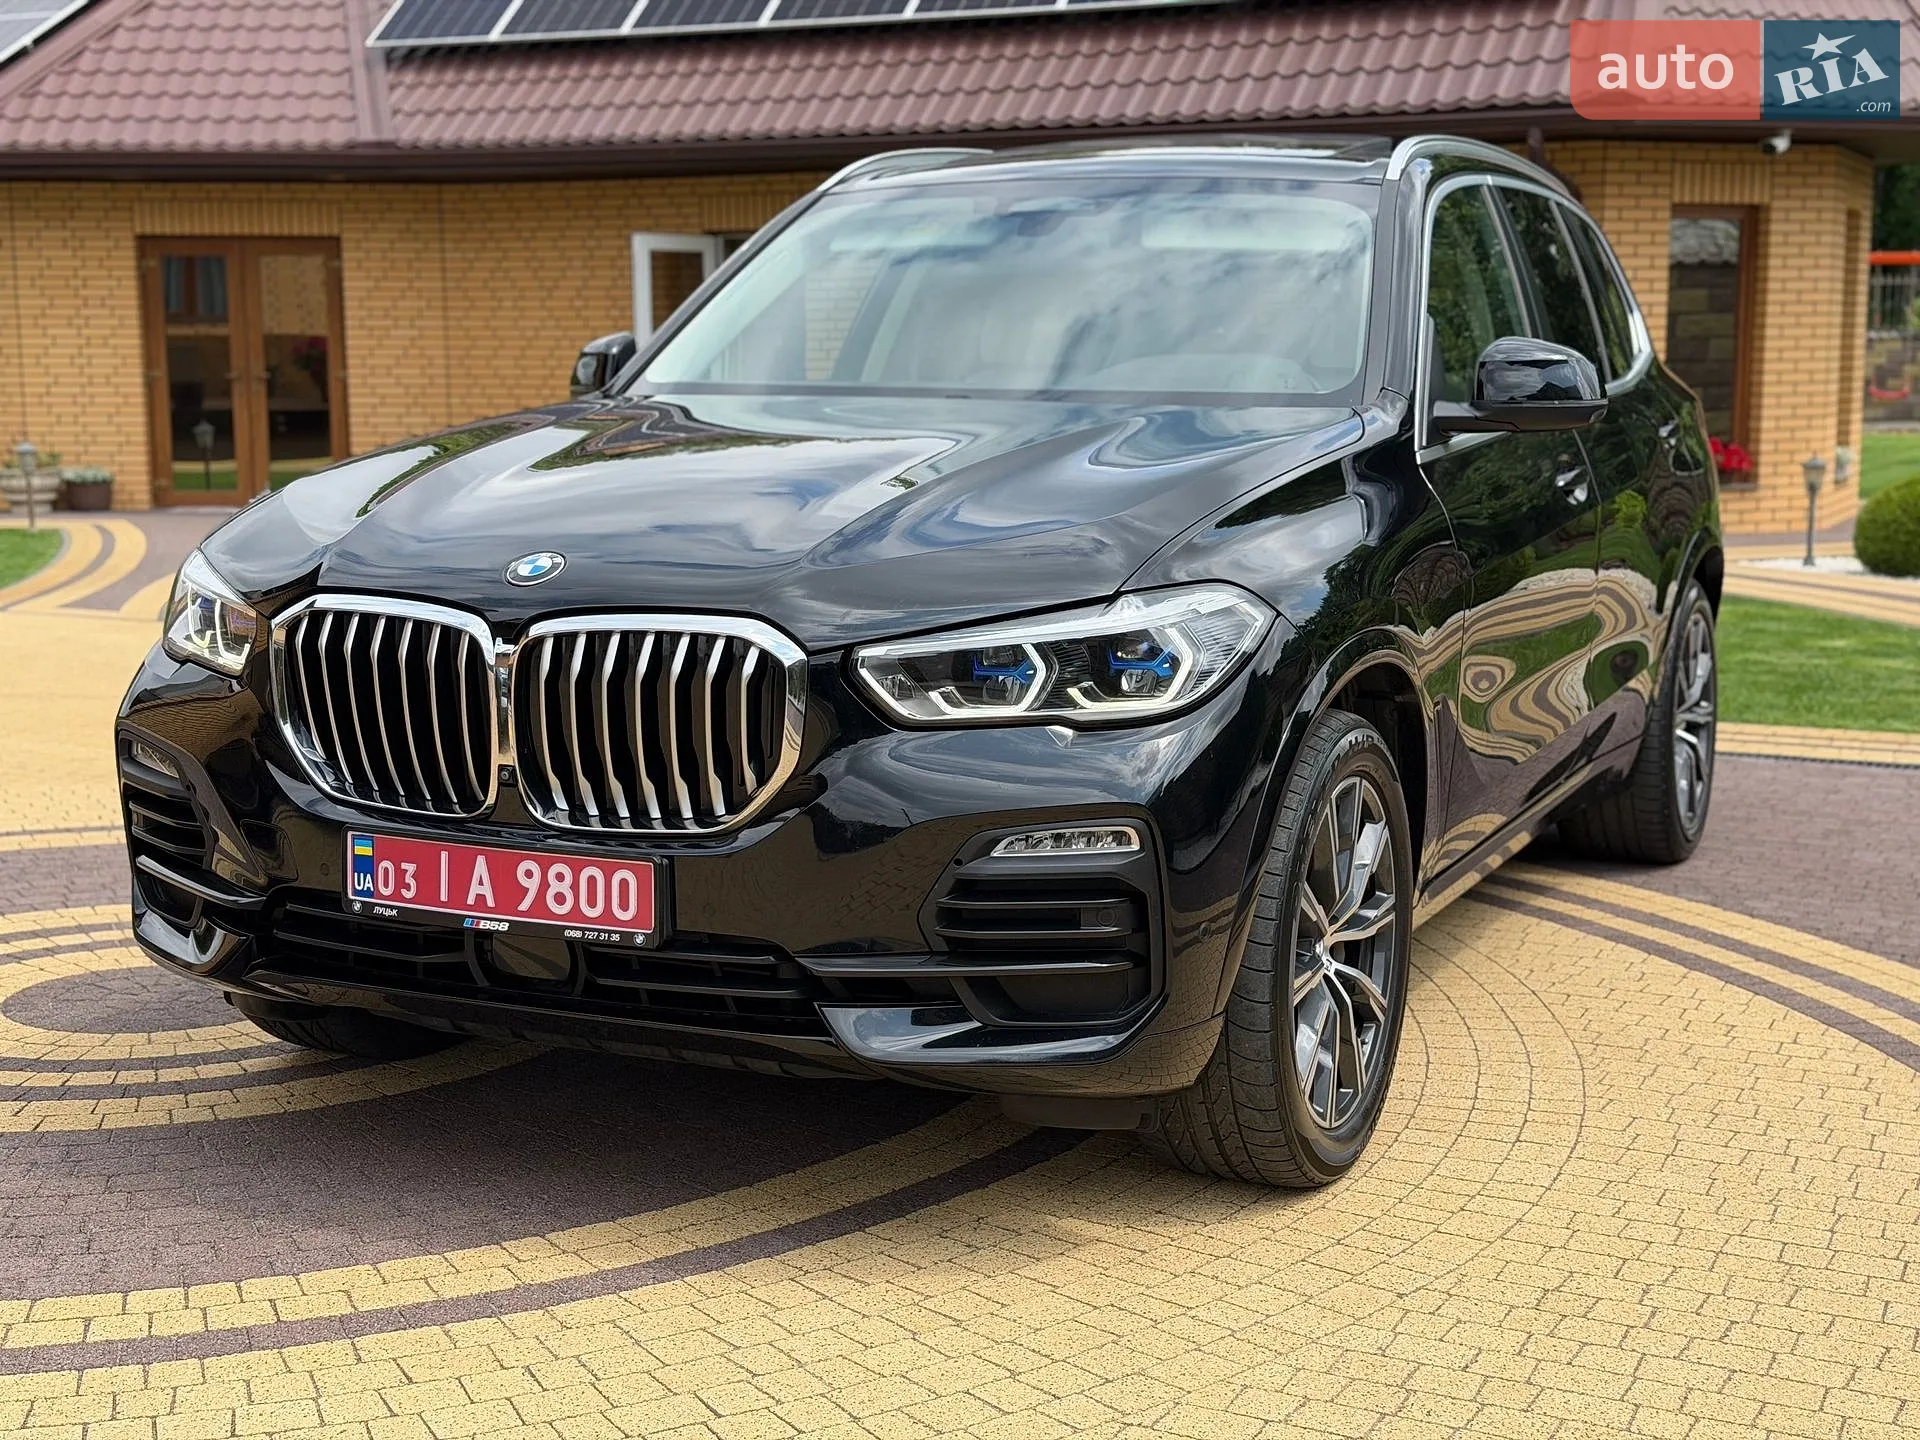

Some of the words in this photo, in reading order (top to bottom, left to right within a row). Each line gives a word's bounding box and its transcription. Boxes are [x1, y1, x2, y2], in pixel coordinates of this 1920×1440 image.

[354, 872, 374, 892] UA
[377, 860, 417, 899] 03
[516, 859, 638, 921] 9800
[584, 931, 598, 939] 727
[599, 932, 608, 940] 31
[610, 933, 620, 941] 35
